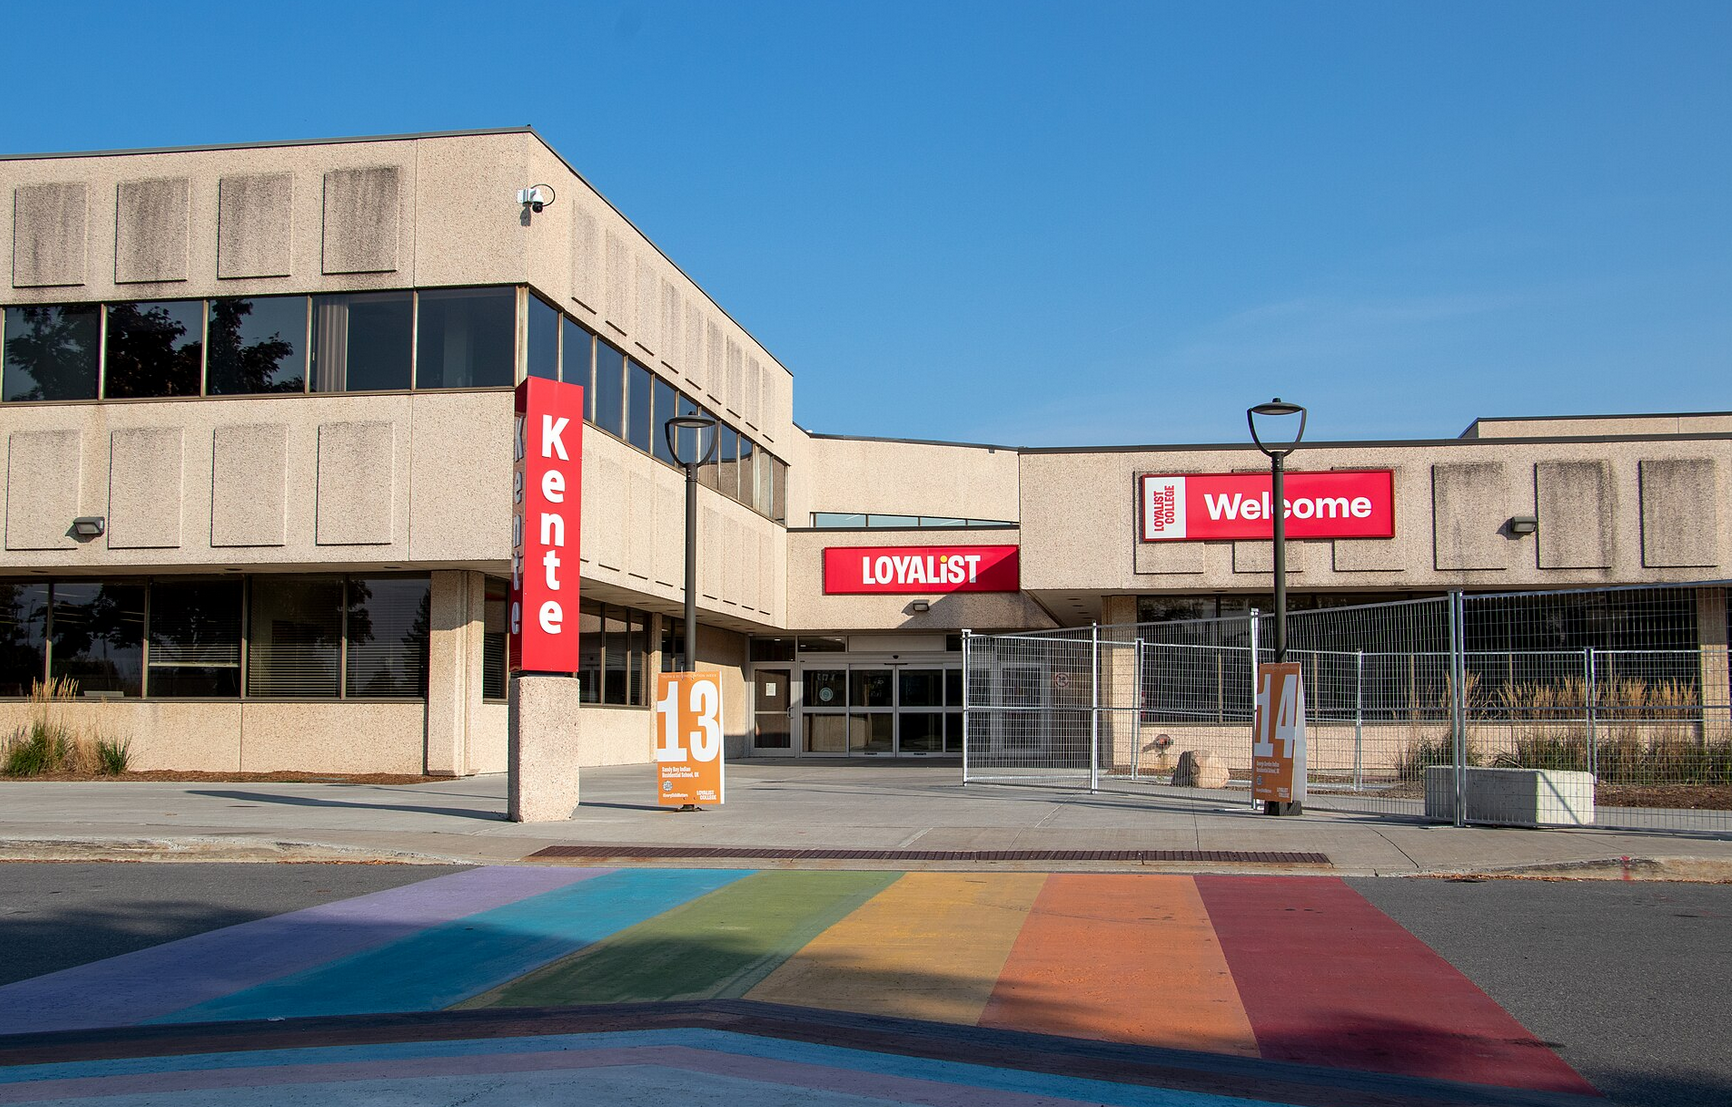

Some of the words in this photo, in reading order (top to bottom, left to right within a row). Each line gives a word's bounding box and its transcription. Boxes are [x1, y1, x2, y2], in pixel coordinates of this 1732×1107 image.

[539, 414, 570, 635] Kente
[1164, 485, 1175, 524] COLLEGE
[1203, 491, 1372, 521] Welcome
[656, 680, 720, 762] 13
[1254, 673, 1298, 759] 14
